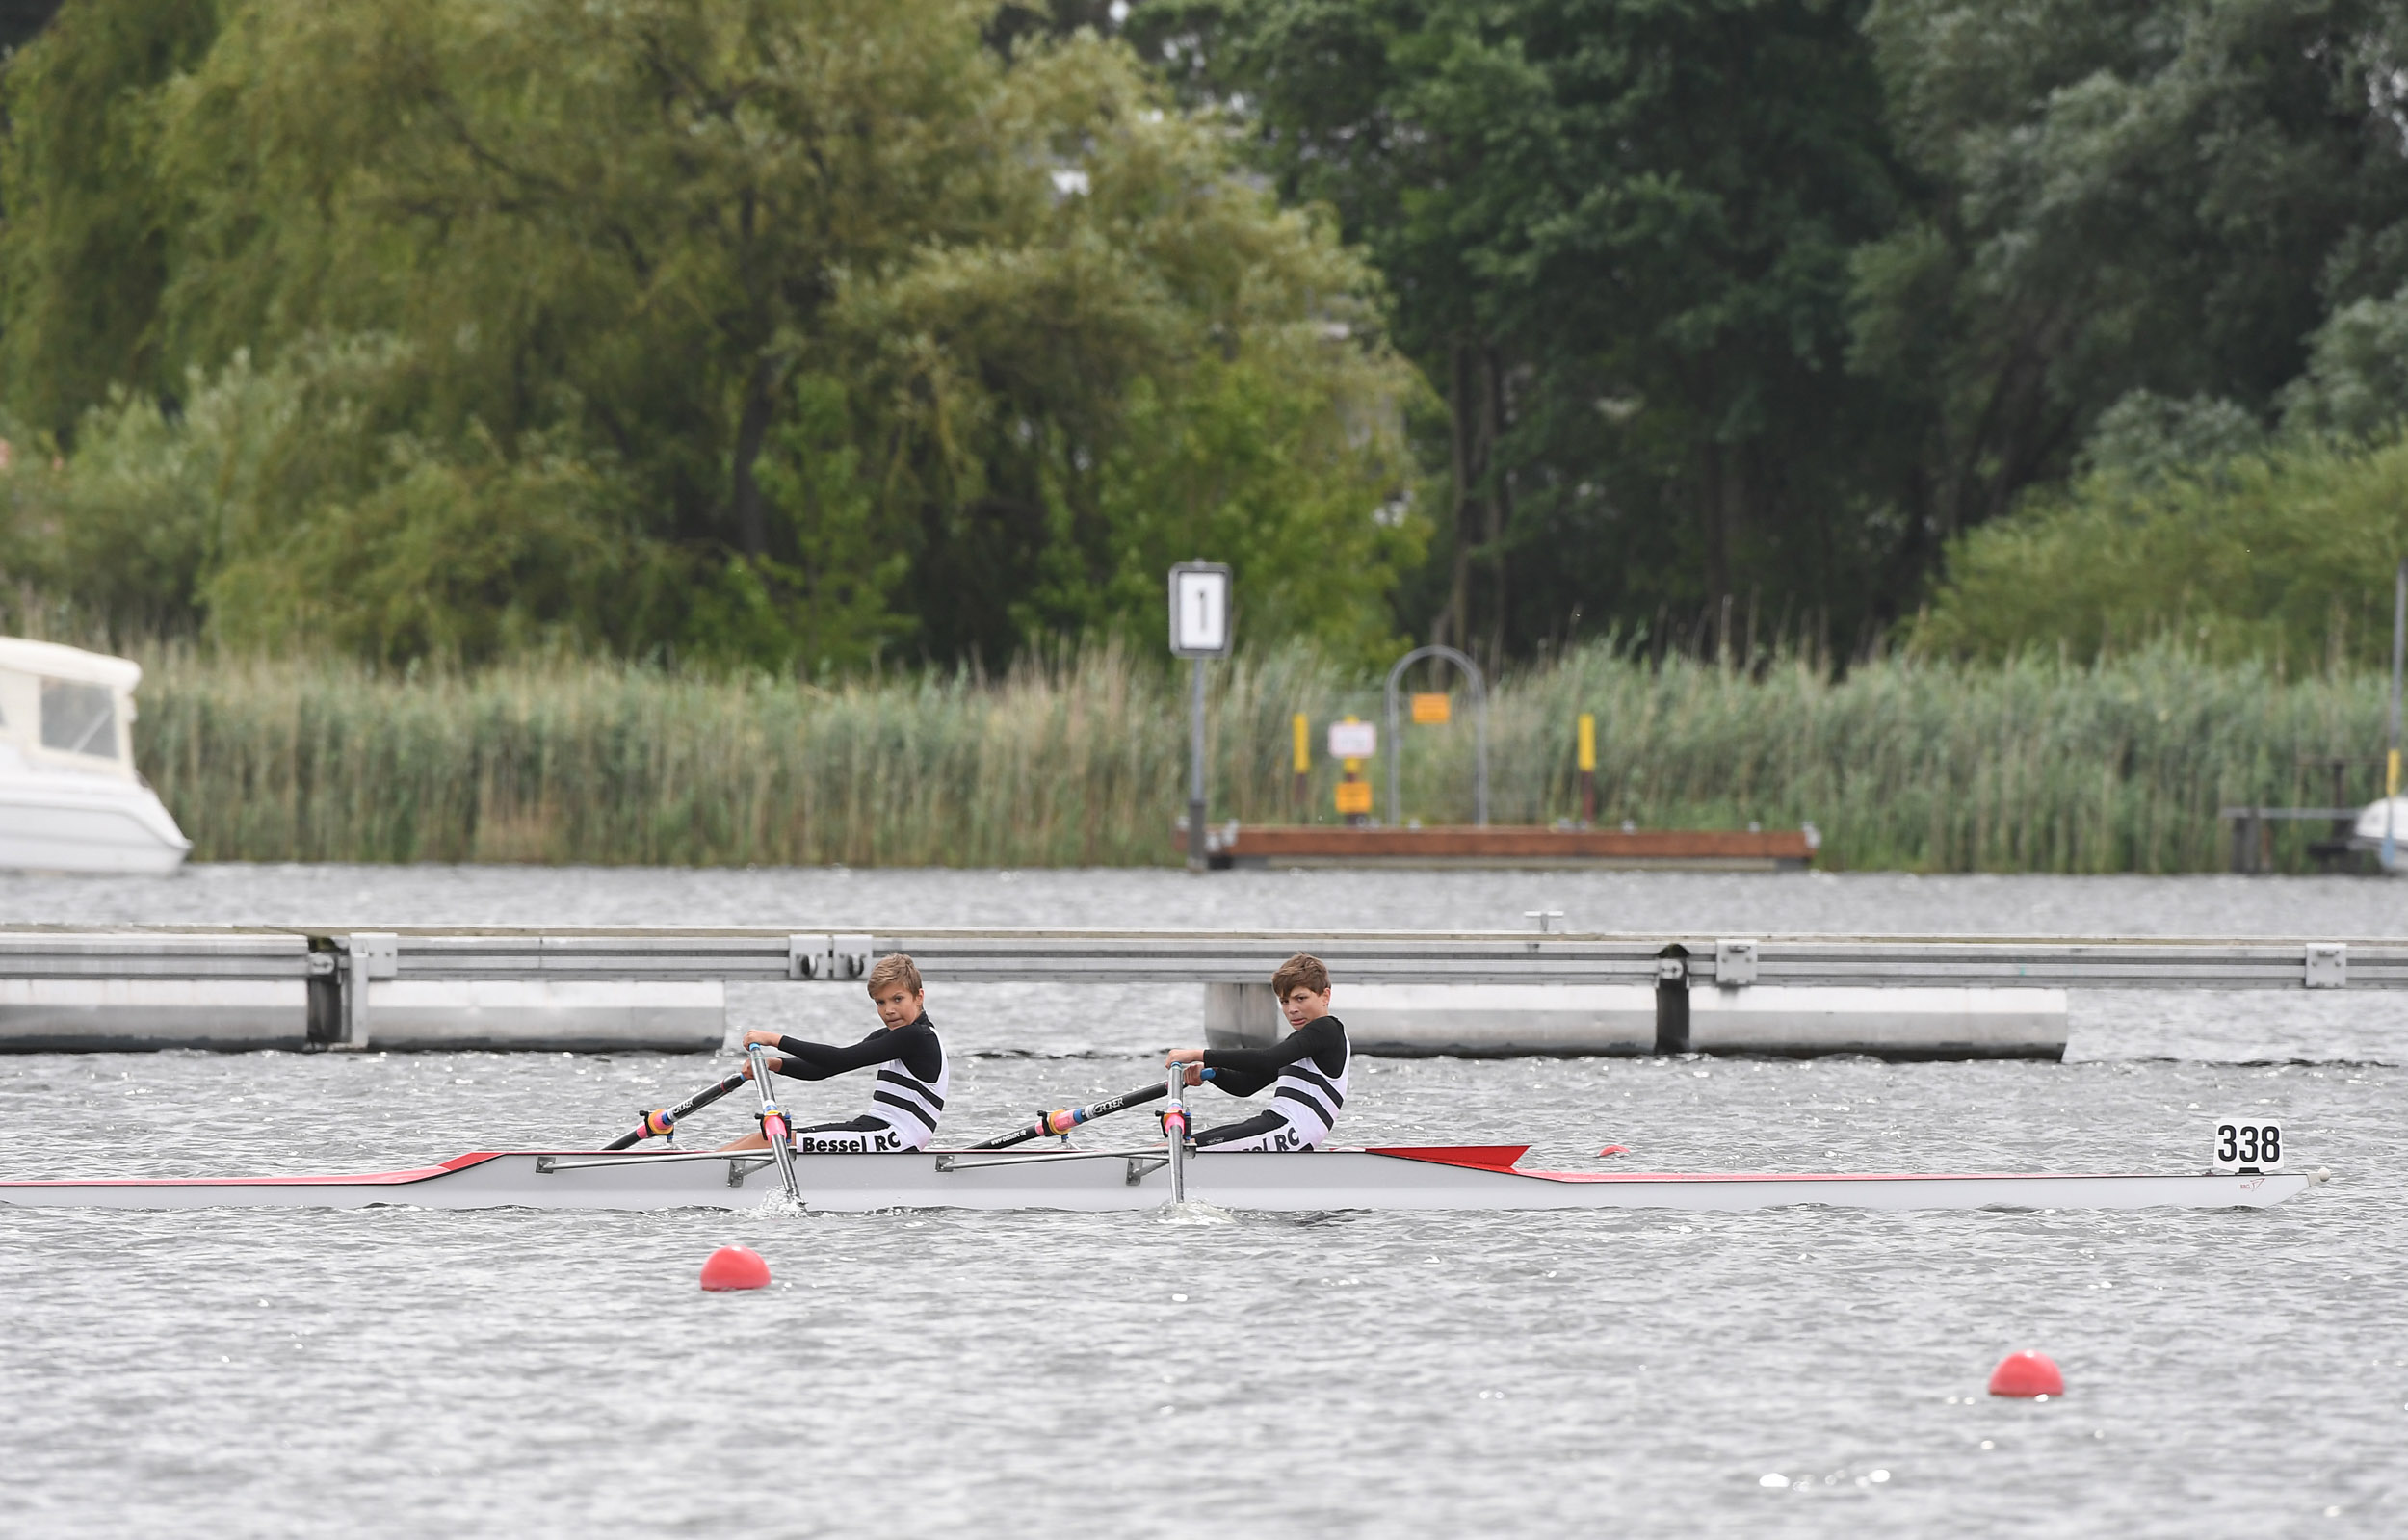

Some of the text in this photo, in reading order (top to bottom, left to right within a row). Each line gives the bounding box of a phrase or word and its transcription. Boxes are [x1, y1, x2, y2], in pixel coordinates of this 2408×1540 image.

[1196, 589, 1208, 632] 1
[1093, 1097, 1124, 1113] CROKER
[802, 1131, 901, 1152] Bessel RC
[1274, 1127, 1300, 1152] RC
[2218, 1125, 2280, 1162] 338
